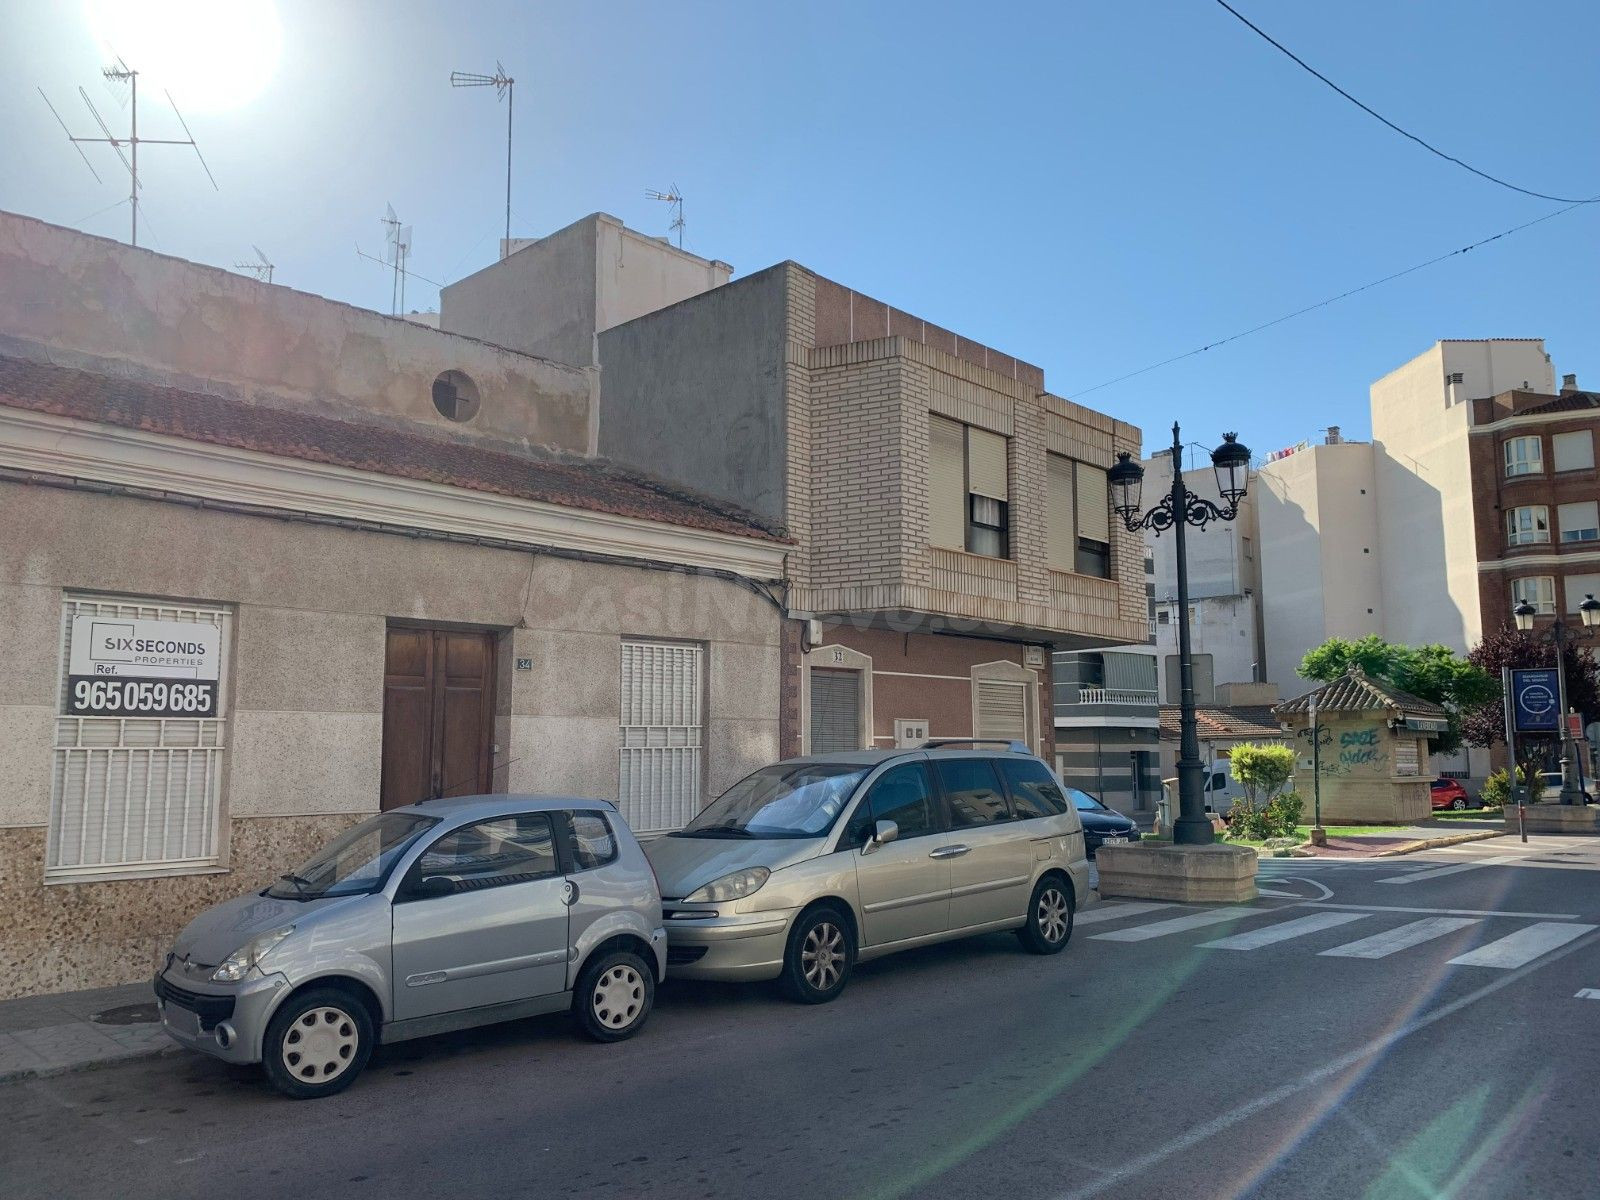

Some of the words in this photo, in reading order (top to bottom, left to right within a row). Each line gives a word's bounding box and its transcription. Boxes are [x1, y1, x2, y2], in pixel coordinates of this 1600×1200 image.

[134, 655, 204, 666] PROPERTIES
[519, 659, 530, 669] 34
[96, 664, 118, 675] Ref.
